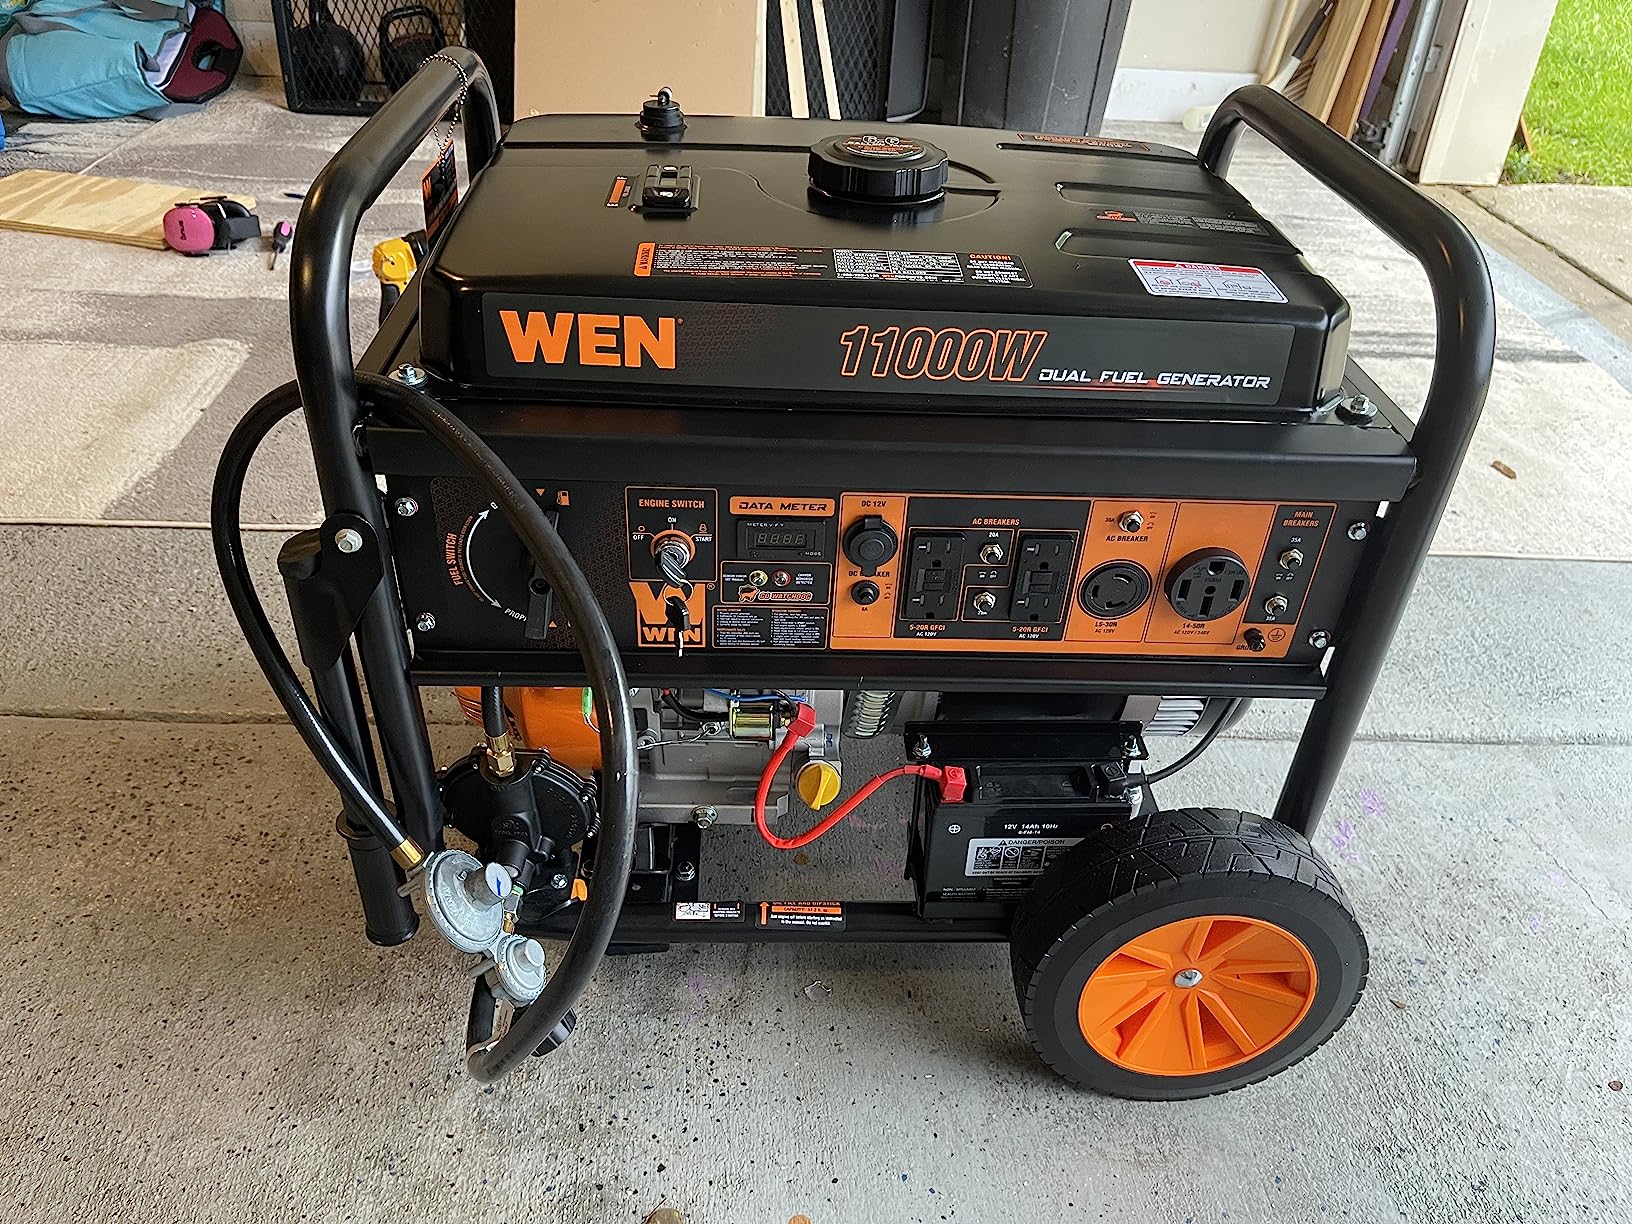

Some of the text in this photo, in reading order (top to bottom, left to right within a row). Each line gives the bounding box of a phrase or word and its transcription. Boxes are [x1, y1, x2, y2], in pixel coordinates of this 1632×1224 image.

[499, 310, 676, 370] WEN
[839, 325, 1049, 383] 11000W
[1038, 368, 1271, 389] DUAL FUEL GENERATOR
[638, 498, 705, 509] ENGINE SWITCH
[738, 502, 828, 511] DATA METER
[972, 518, 982, 526] AC
[445, 533, 463, 586] FUEL SWITCH
[759, 592, 812, 601] CO WATCHDOG
